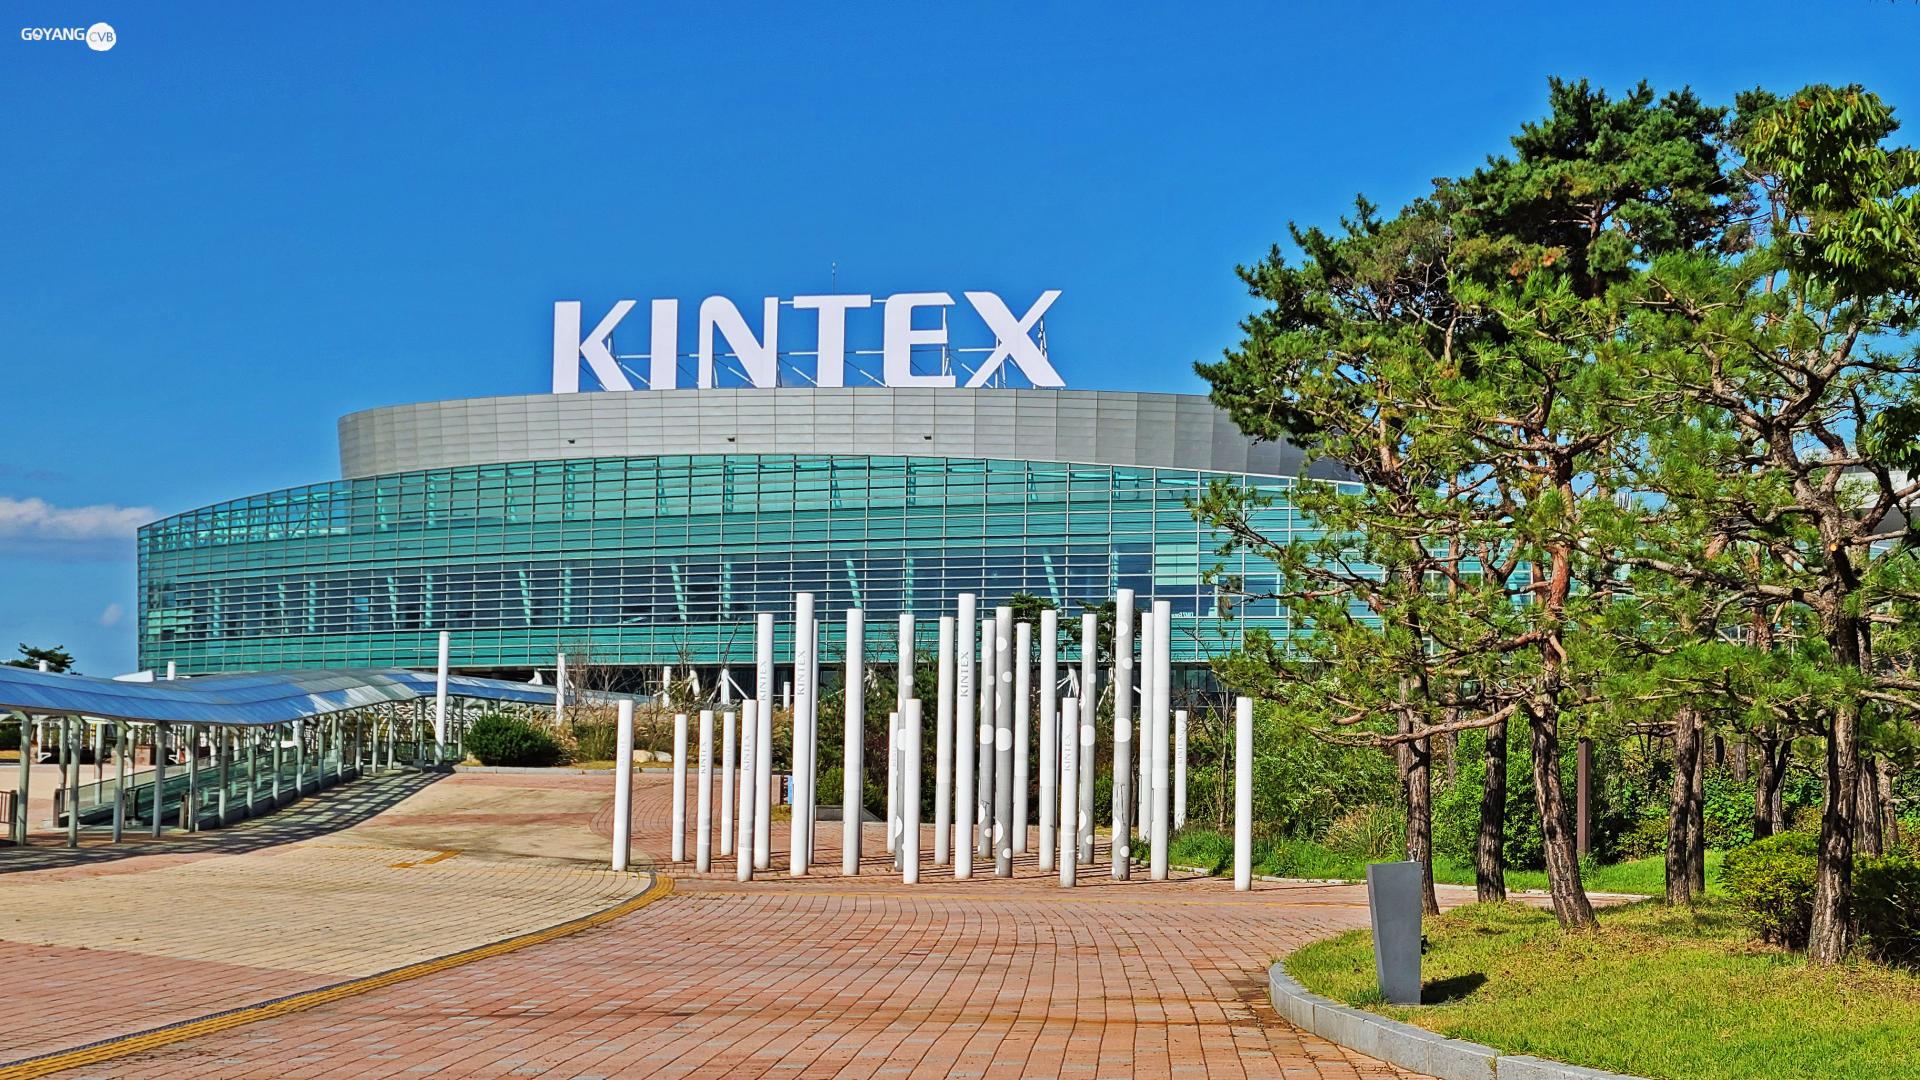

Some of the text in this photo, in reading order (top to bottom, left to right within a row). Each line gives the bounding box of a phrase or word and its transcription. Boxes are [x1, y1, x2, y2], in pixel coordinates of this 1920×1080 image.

[552, 290, 1066, 394] KINTEX
[760, 660, 768, 701] KINTEX
[797, 651, 805, 695] KINTEX
[961, 652, 969, 697] KINTEX
